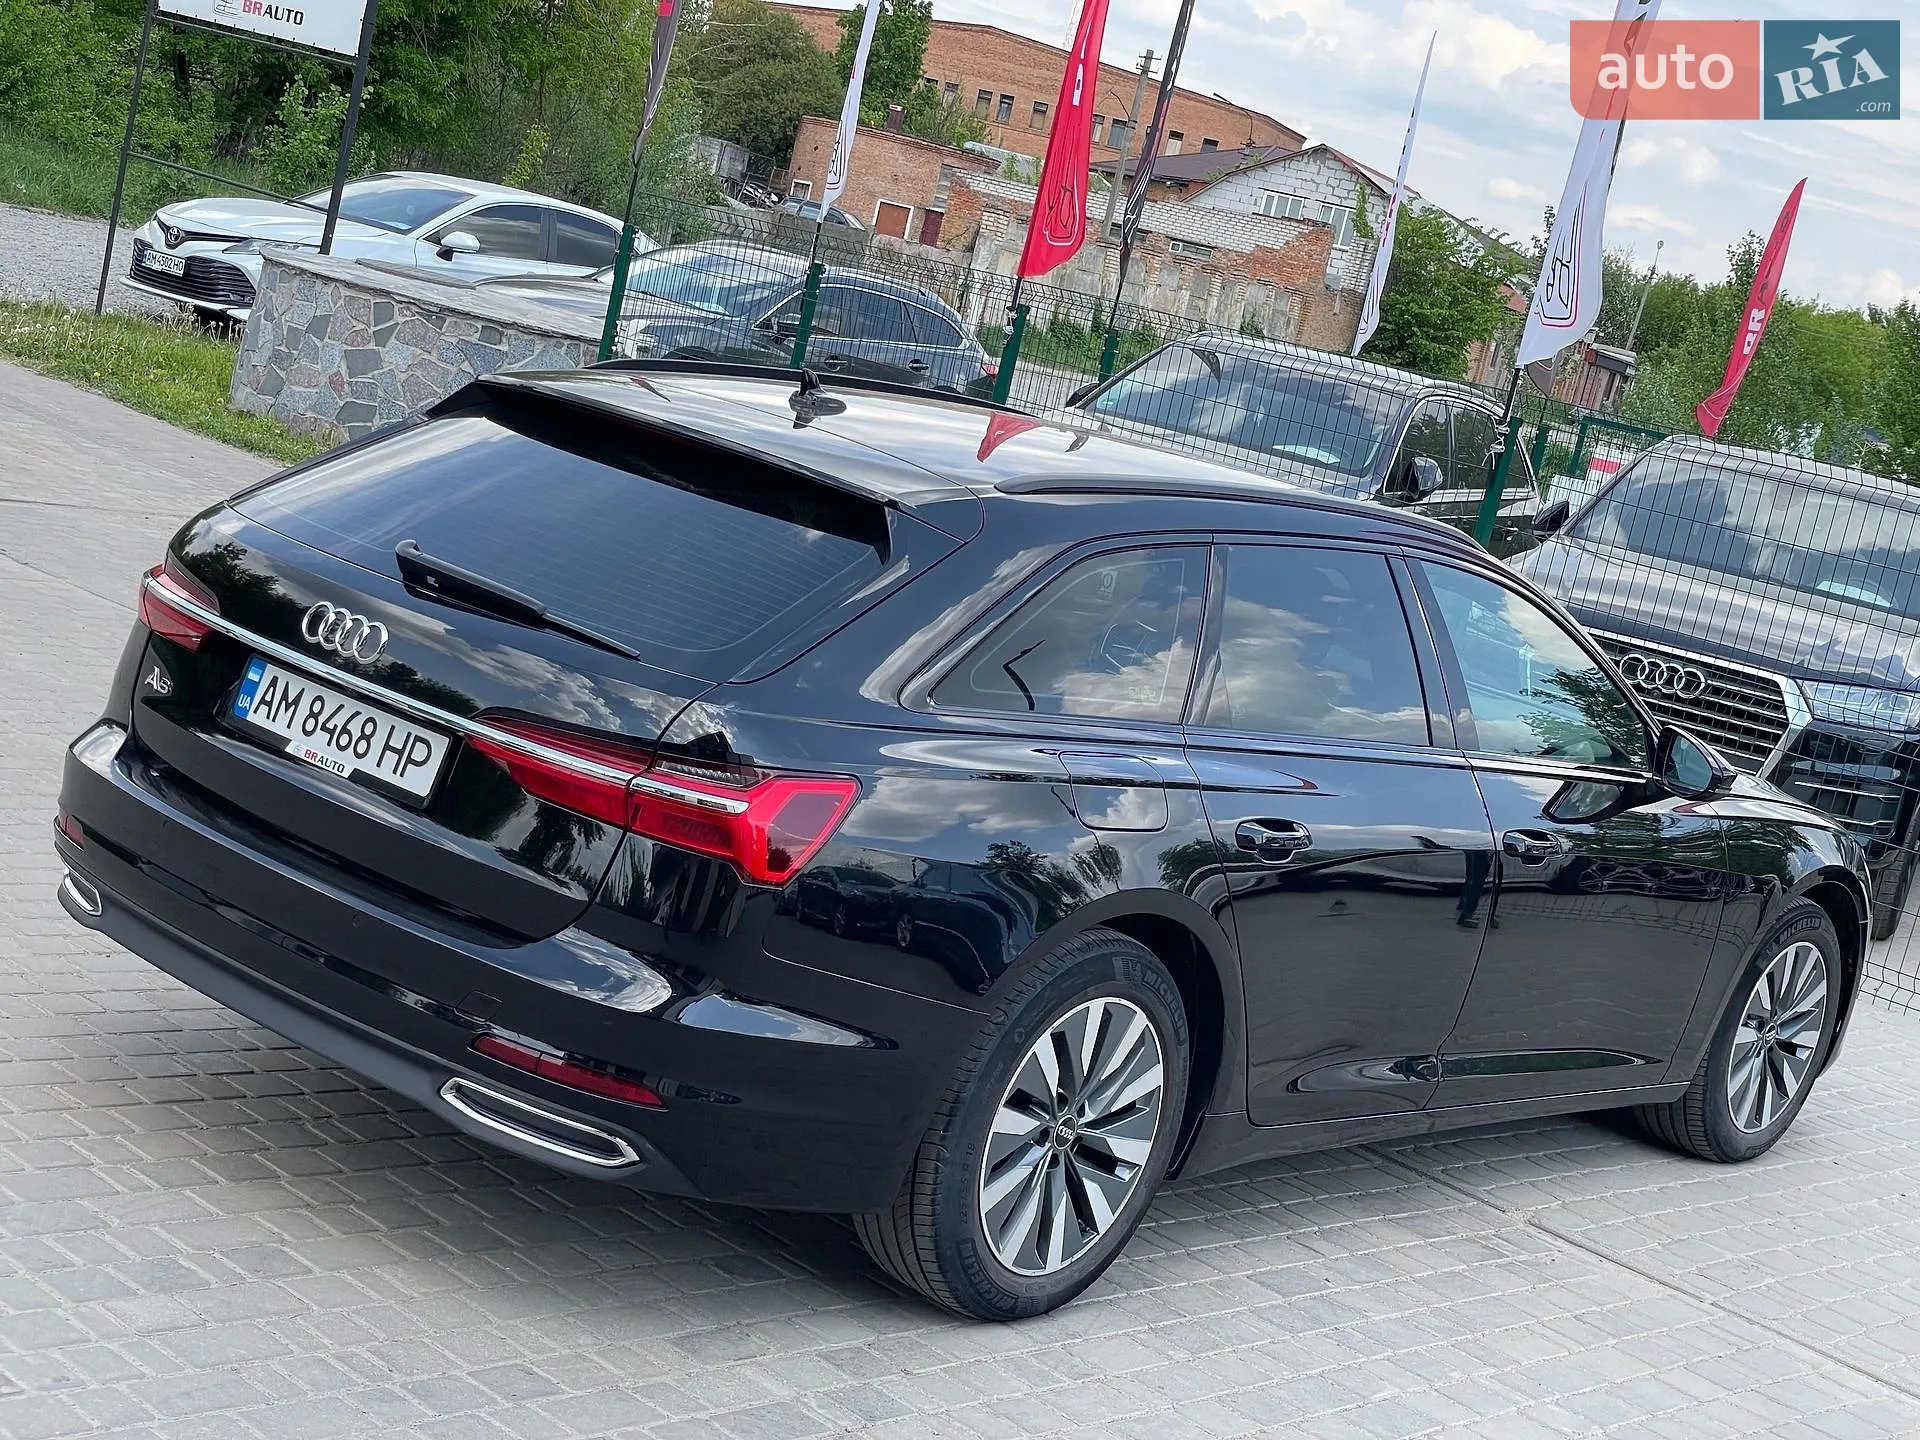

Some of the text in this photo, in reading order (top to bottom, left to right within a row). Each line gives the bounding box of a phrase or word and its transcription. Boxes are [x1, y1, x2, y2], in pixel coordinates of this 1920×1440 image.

[242, 0, 304, 25] BRAUTO
[238, 694, 250, 709] UA
[253, 675, 433, 778] AM 8468 HP
[304, 749, 345, 774] BRAUTO
